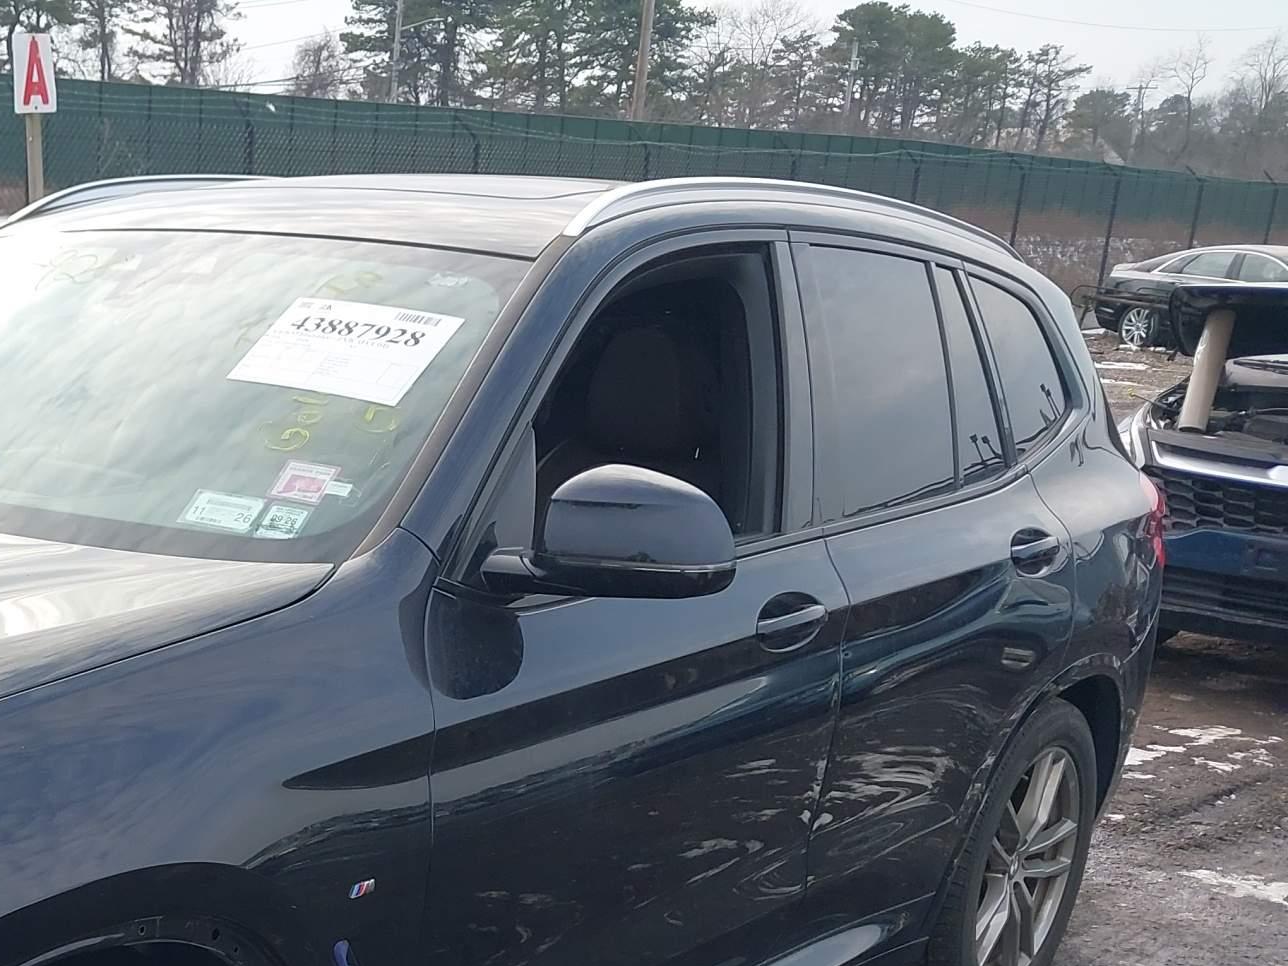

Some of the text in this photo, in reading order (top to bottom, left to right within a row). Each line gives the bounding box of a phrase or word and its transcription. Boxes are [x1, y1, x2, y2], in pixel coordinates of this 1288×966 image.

[23, 37, 49, 105] A
[290, 315, 427, 349] 43887928
[233, 512, 252, 525] 26
